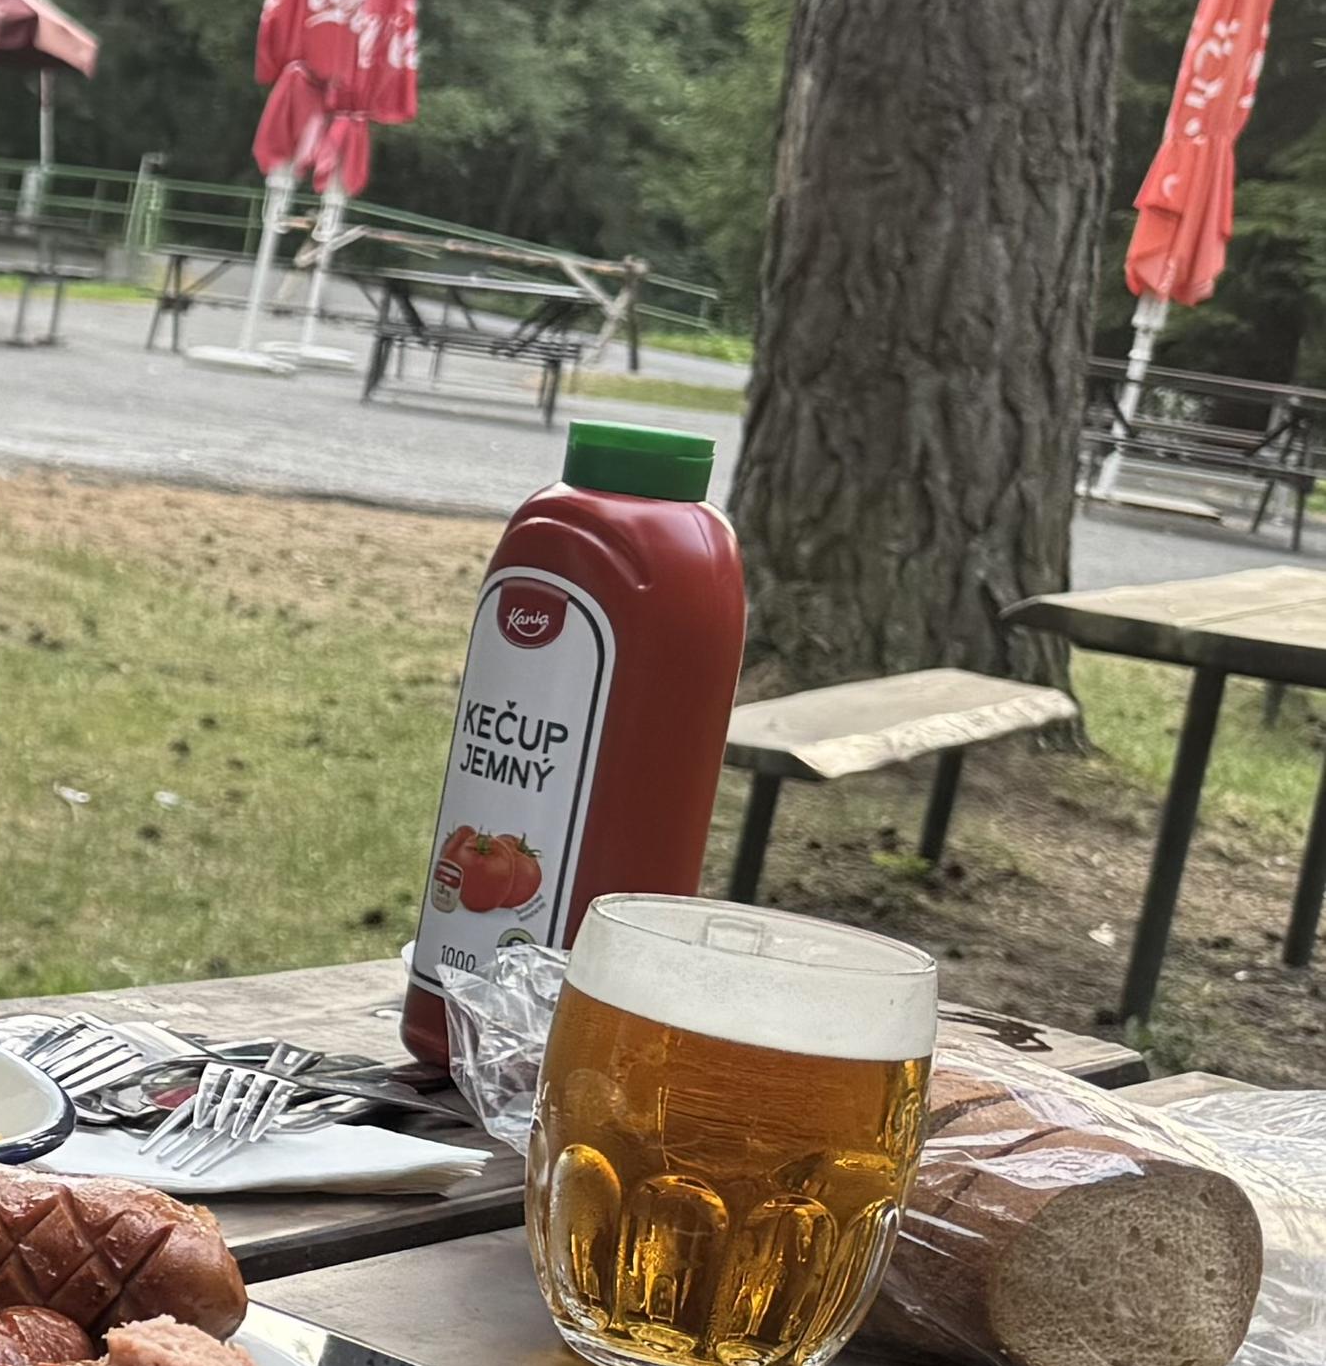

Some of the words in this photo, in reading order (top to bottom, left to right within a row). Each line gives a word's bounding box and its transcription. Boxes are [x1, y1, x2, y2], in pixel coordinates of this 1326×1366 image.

[506, 606, 550, 637] Kania
[462, 699, 569, 755] KEČUP
[459, 743, 556, 793] JEMNÝ
[441, 944, 477, 973] 1000
